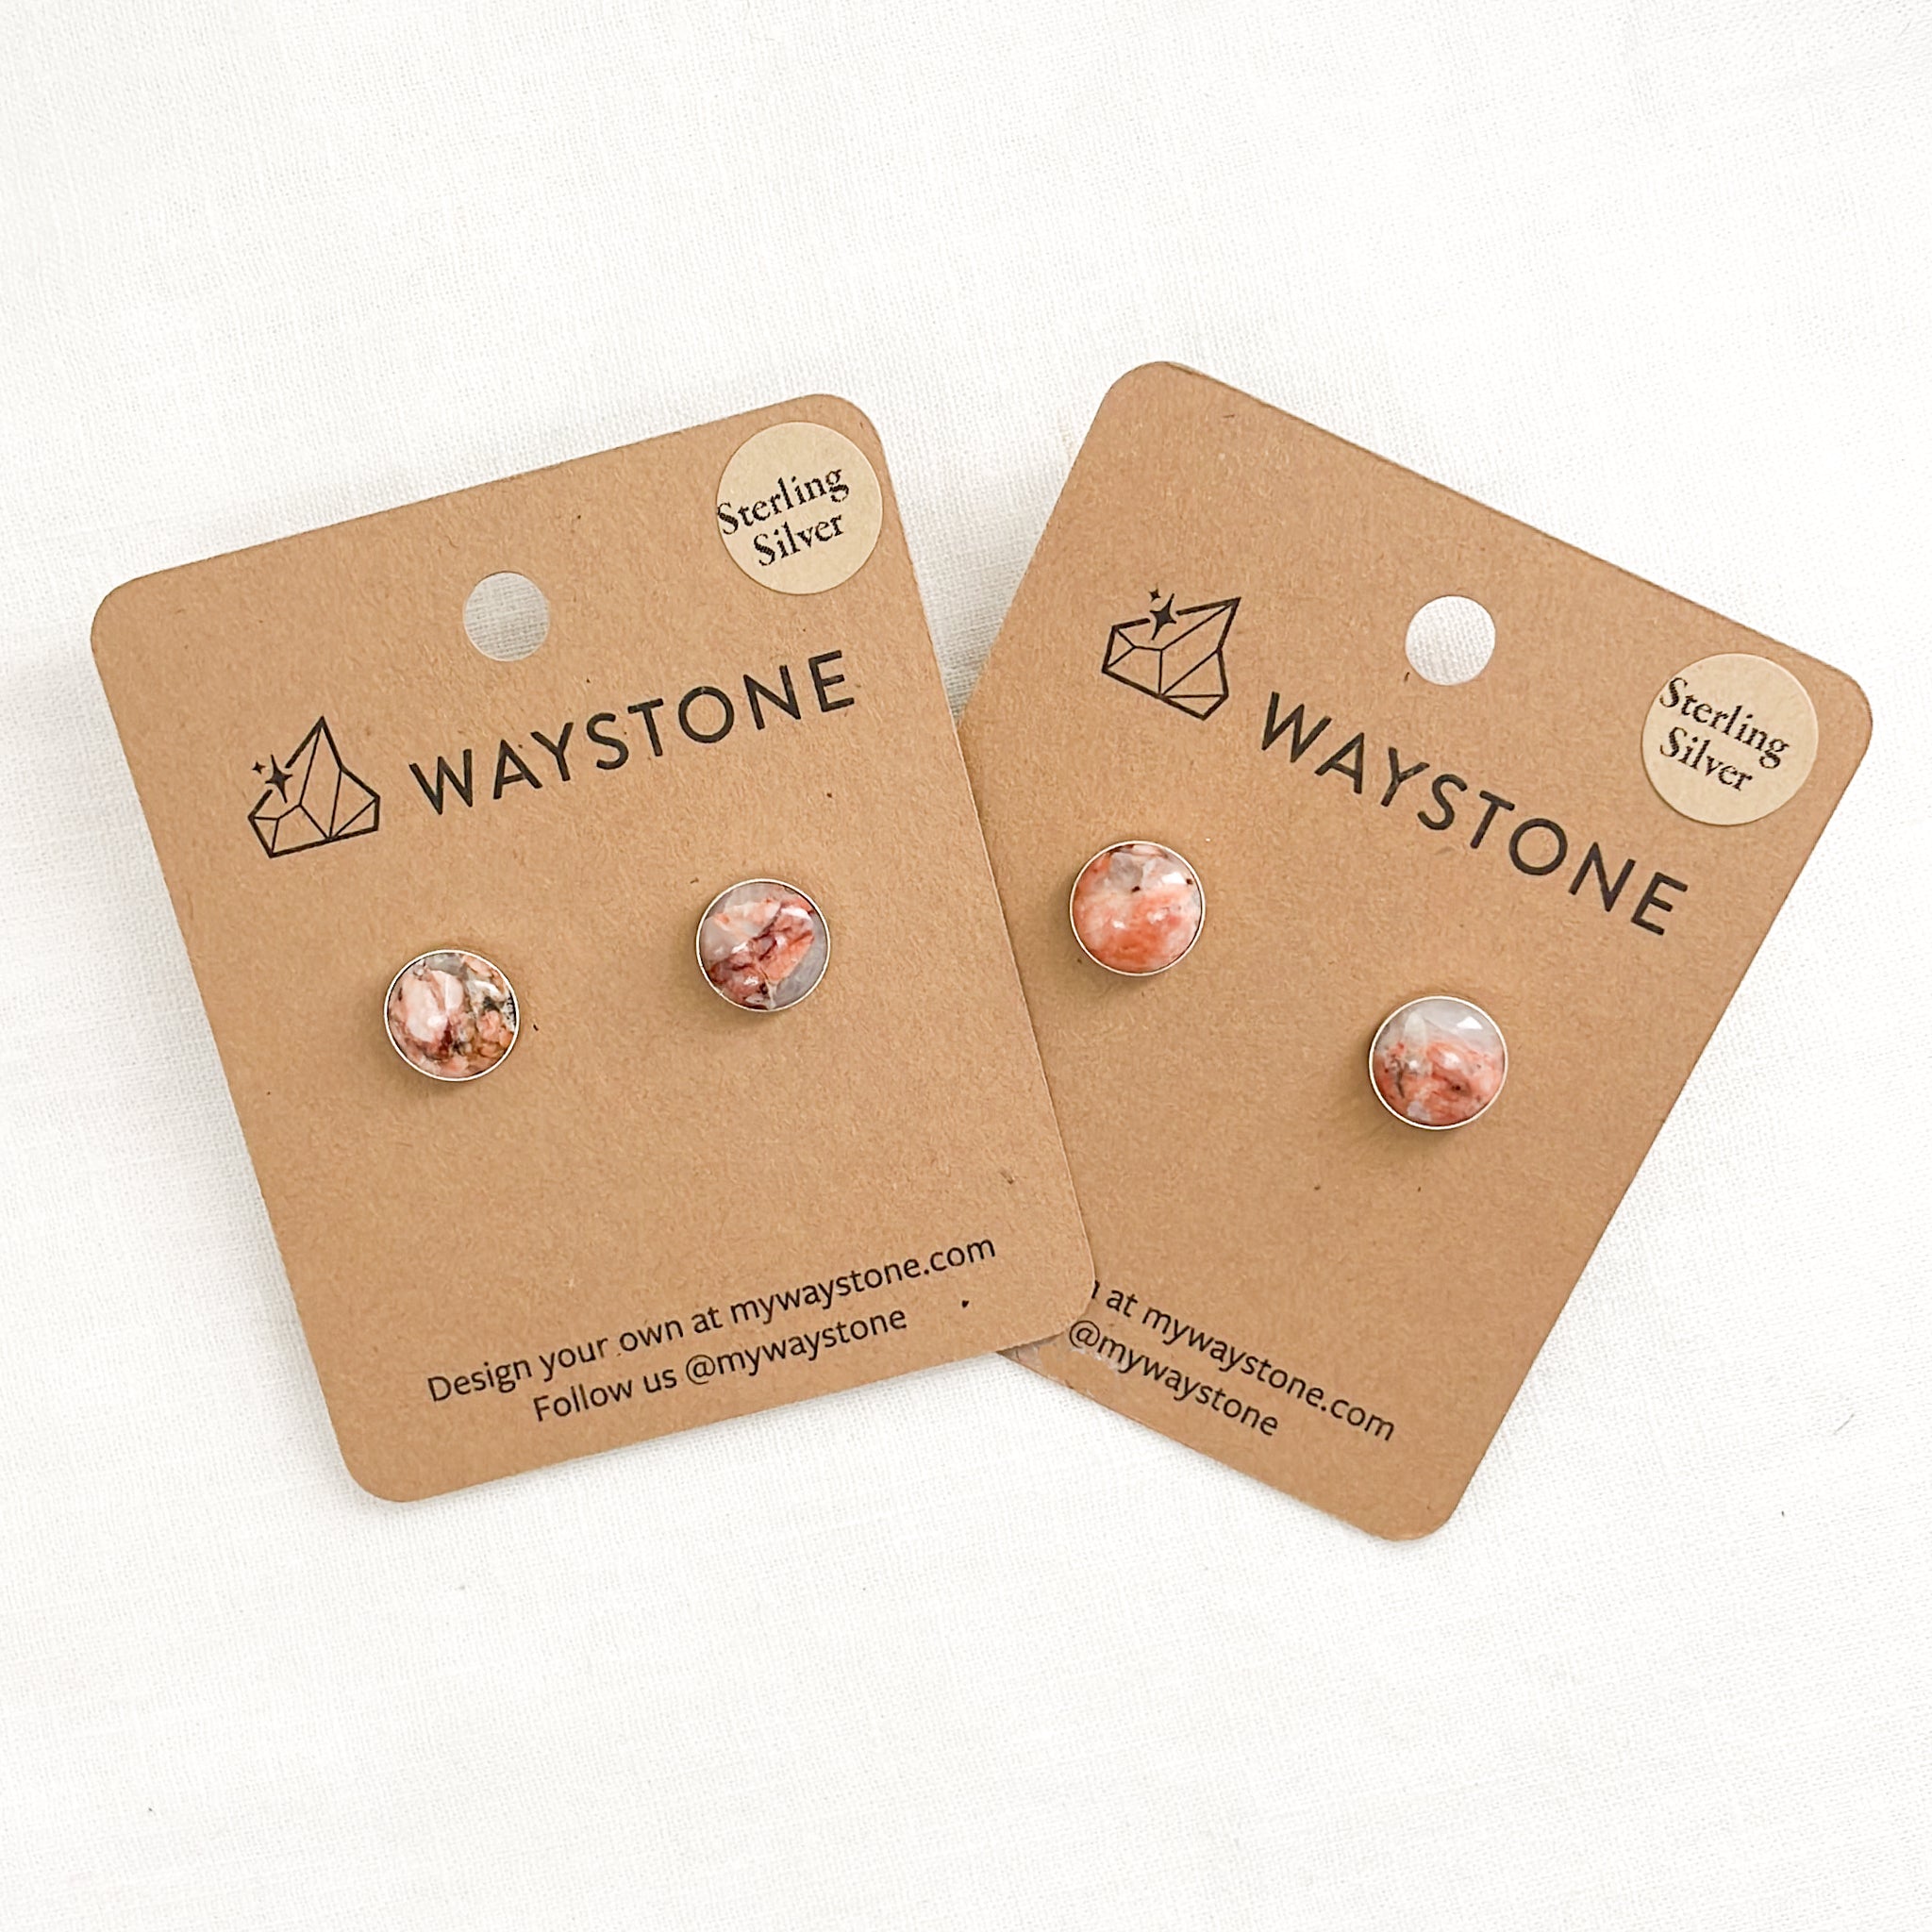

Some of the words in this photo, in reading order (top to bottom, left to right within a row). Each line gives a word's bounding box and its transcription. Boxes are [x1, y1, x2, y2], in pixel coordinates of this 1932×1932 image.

[717, 469, 850, 535] Sterling
[753, 514, 844, 566] Silver
[409, 650, 855, 816] WAYSTONE
[1659, 676, 1790, 769] Sterling
[1659, 726, 1753, 791] Silver
[1262, 691, 1689, 936] WAYSTONE
[427, 1359, 533, 1403] Design
[539, 1338, 609, 1383] your
[619, 1320, 684, 1352] own
[691, 1306, 724, 1334] at
[730, 1238, 996, 1325] mywaystone.com
[533, 1379, 634, 1422] Follow
[642, 1369, 678, 1393] us
[685, 1308, 908, 1386] @mywaystone
[1106, 1289, 1139, 1318] at
[1141, 1306, 1395, 1441] mywaystone.com
[1069, 1320, 1279, 1437] @mywaystone
